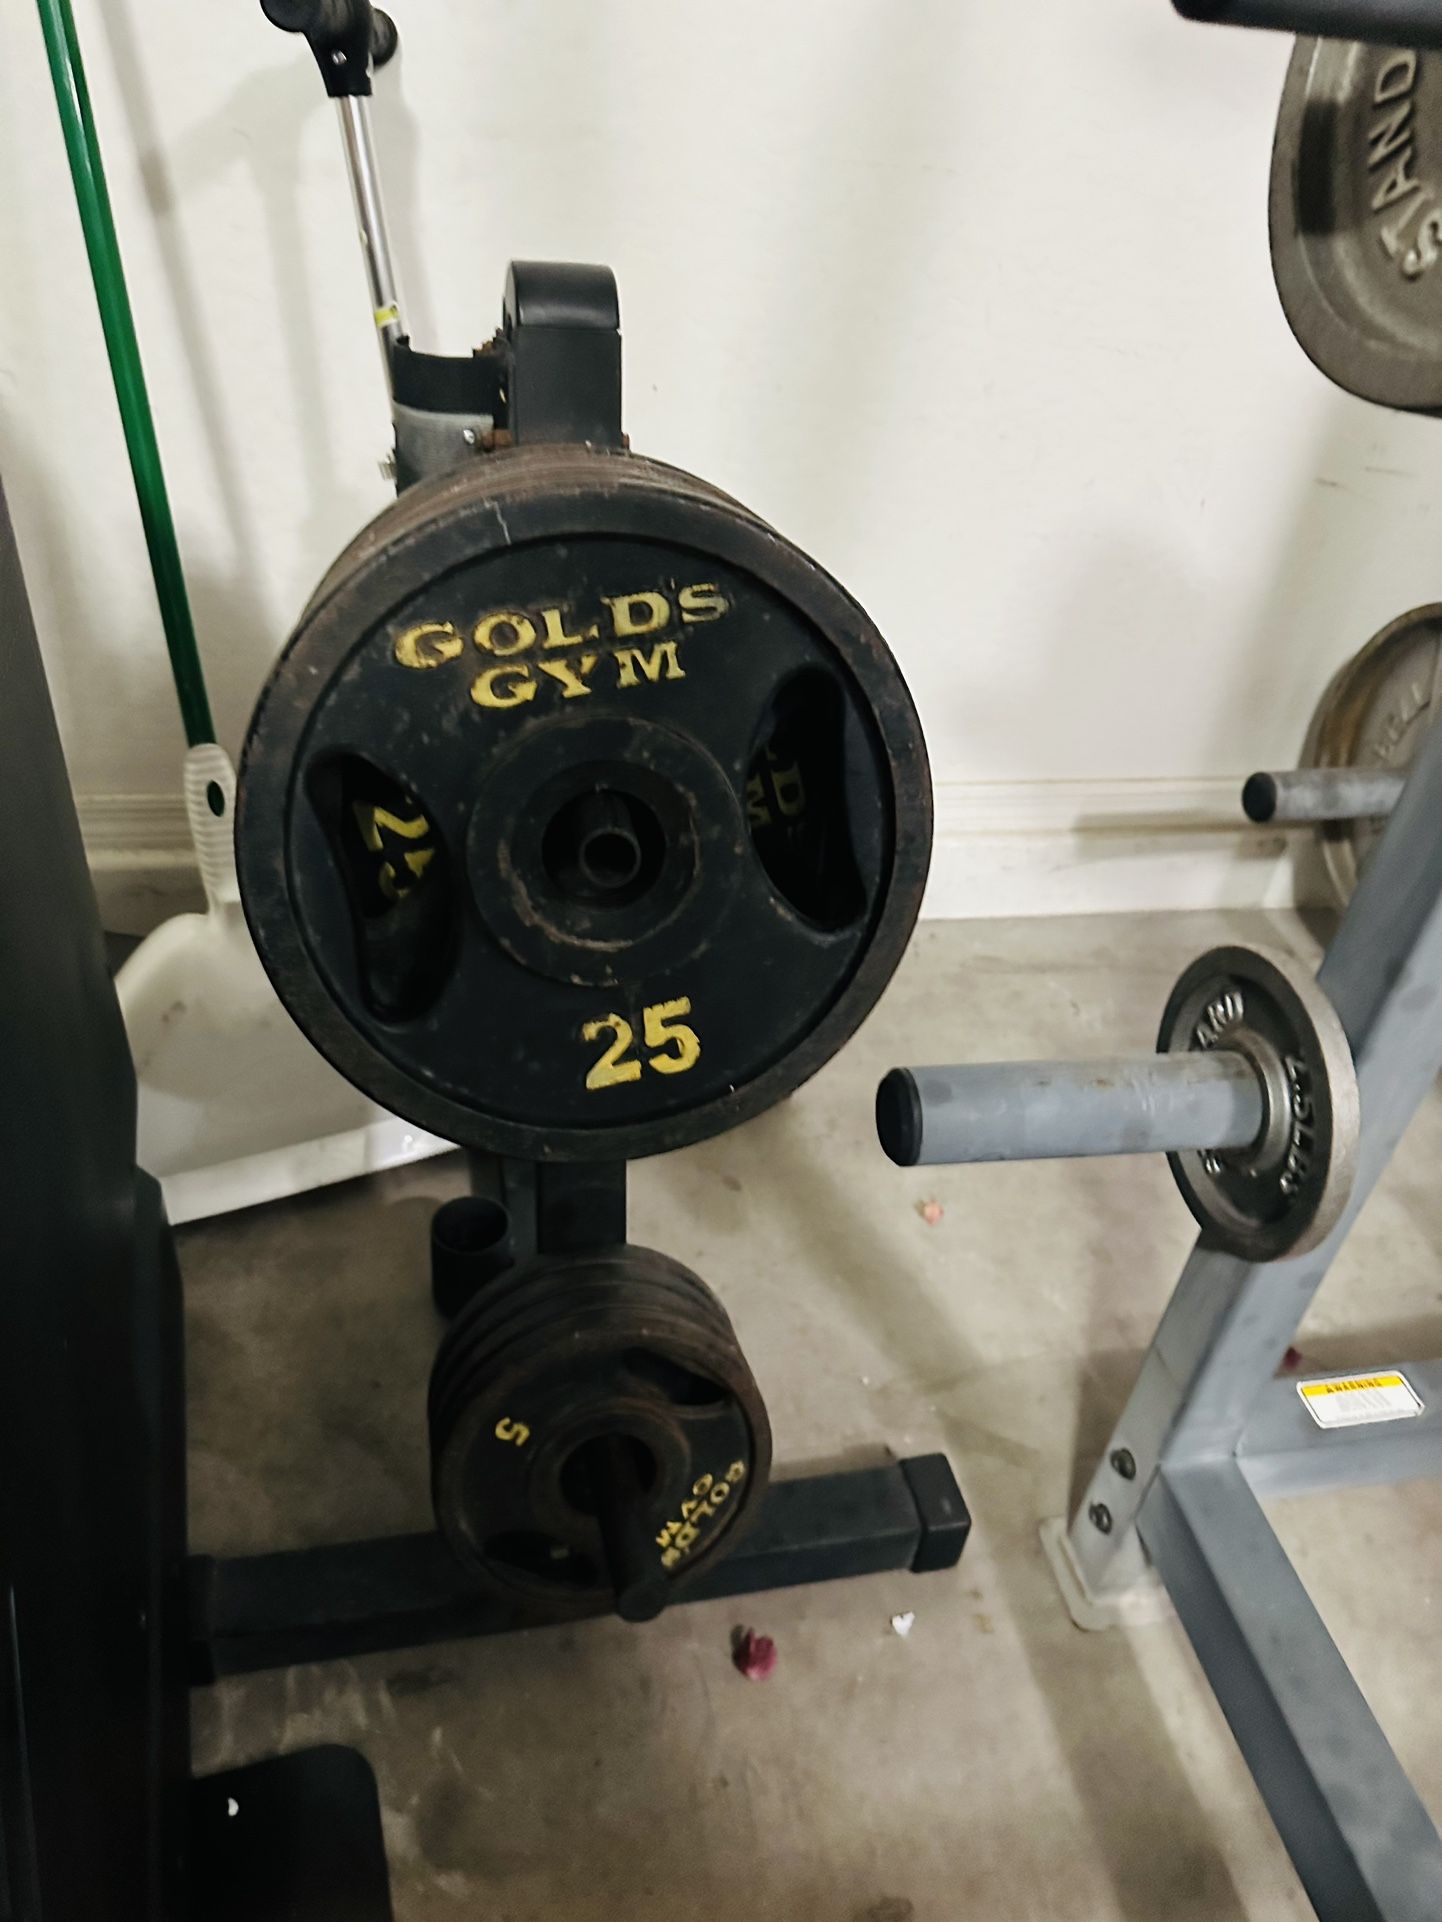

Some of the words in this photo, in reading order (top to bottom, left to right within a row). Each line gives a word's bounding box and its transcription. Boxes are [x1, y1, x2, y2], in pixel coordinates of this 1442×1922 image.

[470, 641, 686, 709] GYM
[582, 996, 701, 1090] 25
[494, 1416, 530, 1447] 5
[655, 1473, 714, 1548] GYM
